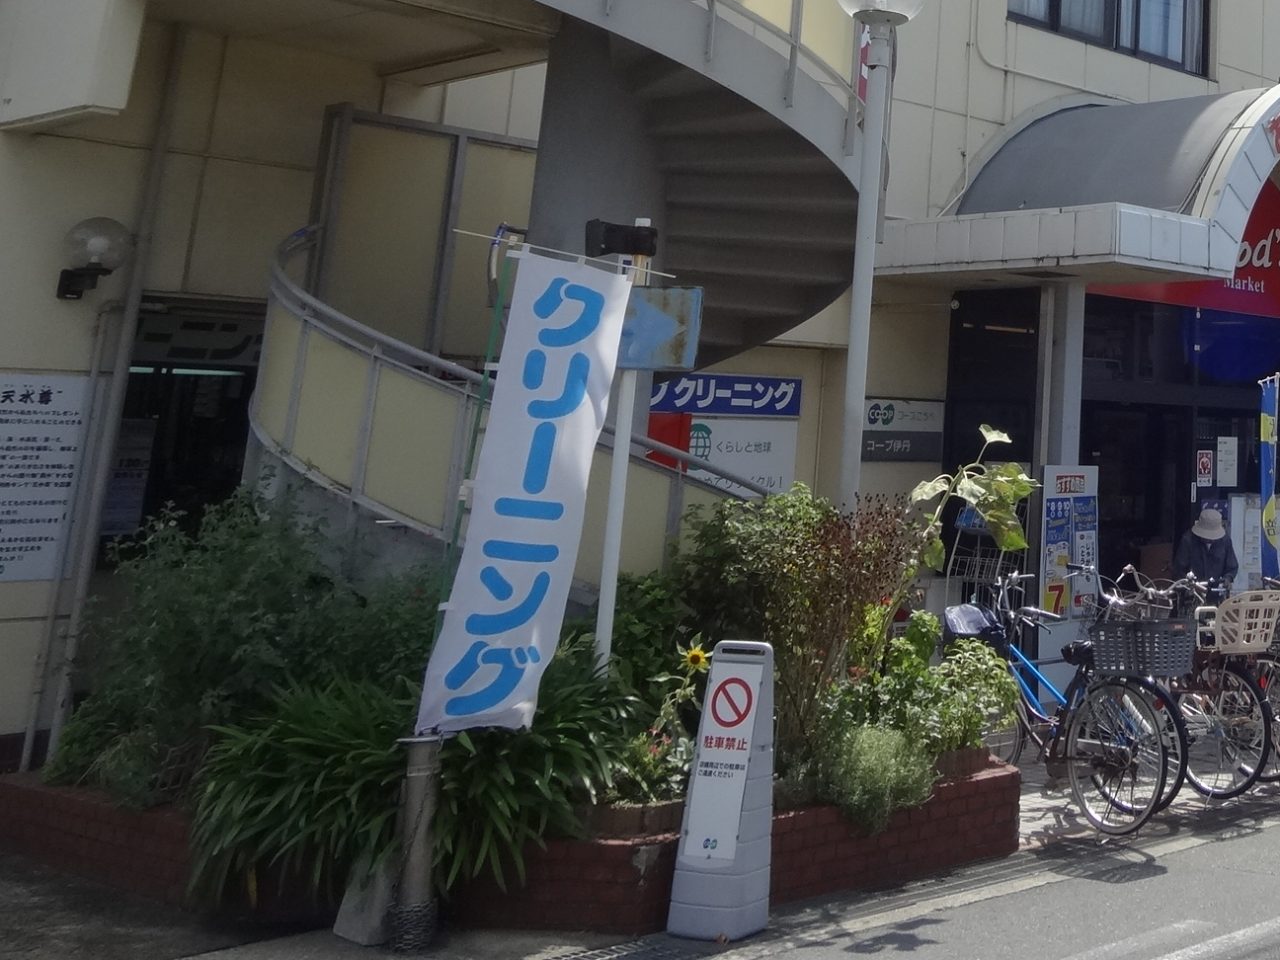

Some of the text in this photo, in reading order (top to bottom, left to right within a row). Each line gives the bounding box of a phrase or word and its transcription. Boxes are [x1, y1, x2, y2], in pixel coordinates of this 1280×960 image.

[715, 442, 772, 454] くらしと地球
[866, 440, 912, 454] コープ伊丹
[444, 276, 606, 717] クリーニング
[704, 735, 748, 751] 駐車禁止
